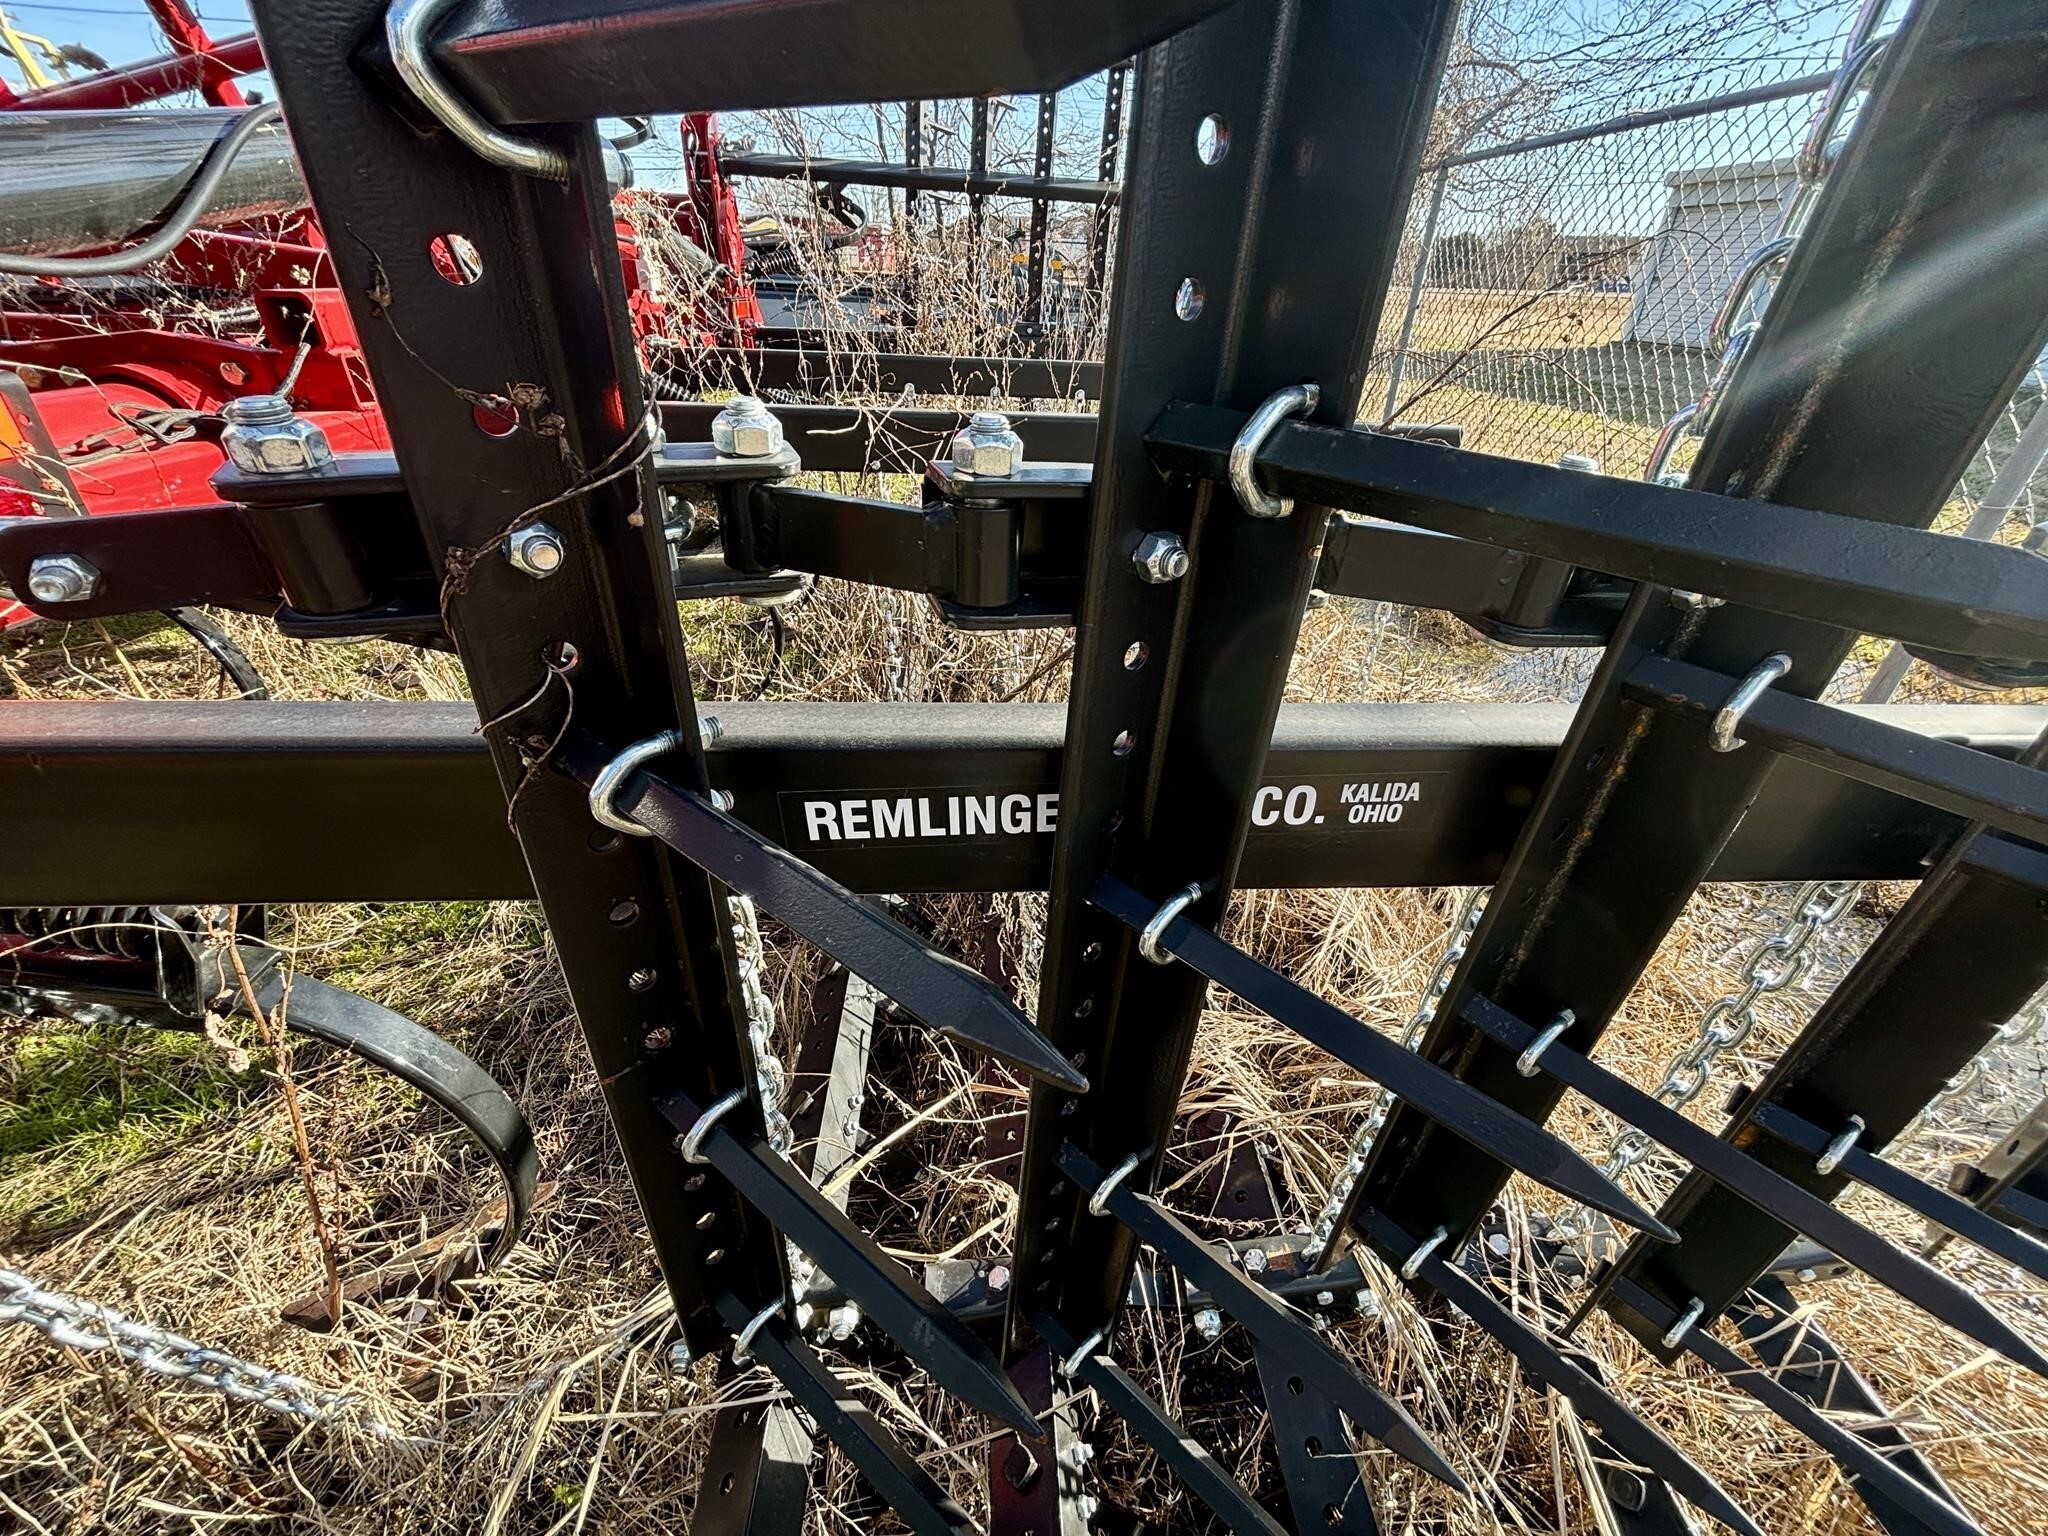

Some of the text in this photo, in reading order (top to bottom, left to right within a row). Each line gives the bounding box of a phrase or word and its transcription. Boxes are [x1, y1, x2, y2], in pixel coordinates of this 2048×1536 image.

[1340, 782, 1420, 804] KALIDA
[1251, 785, 1325, 827] CO.
[1348, 803, 1404, 824] OHIO
